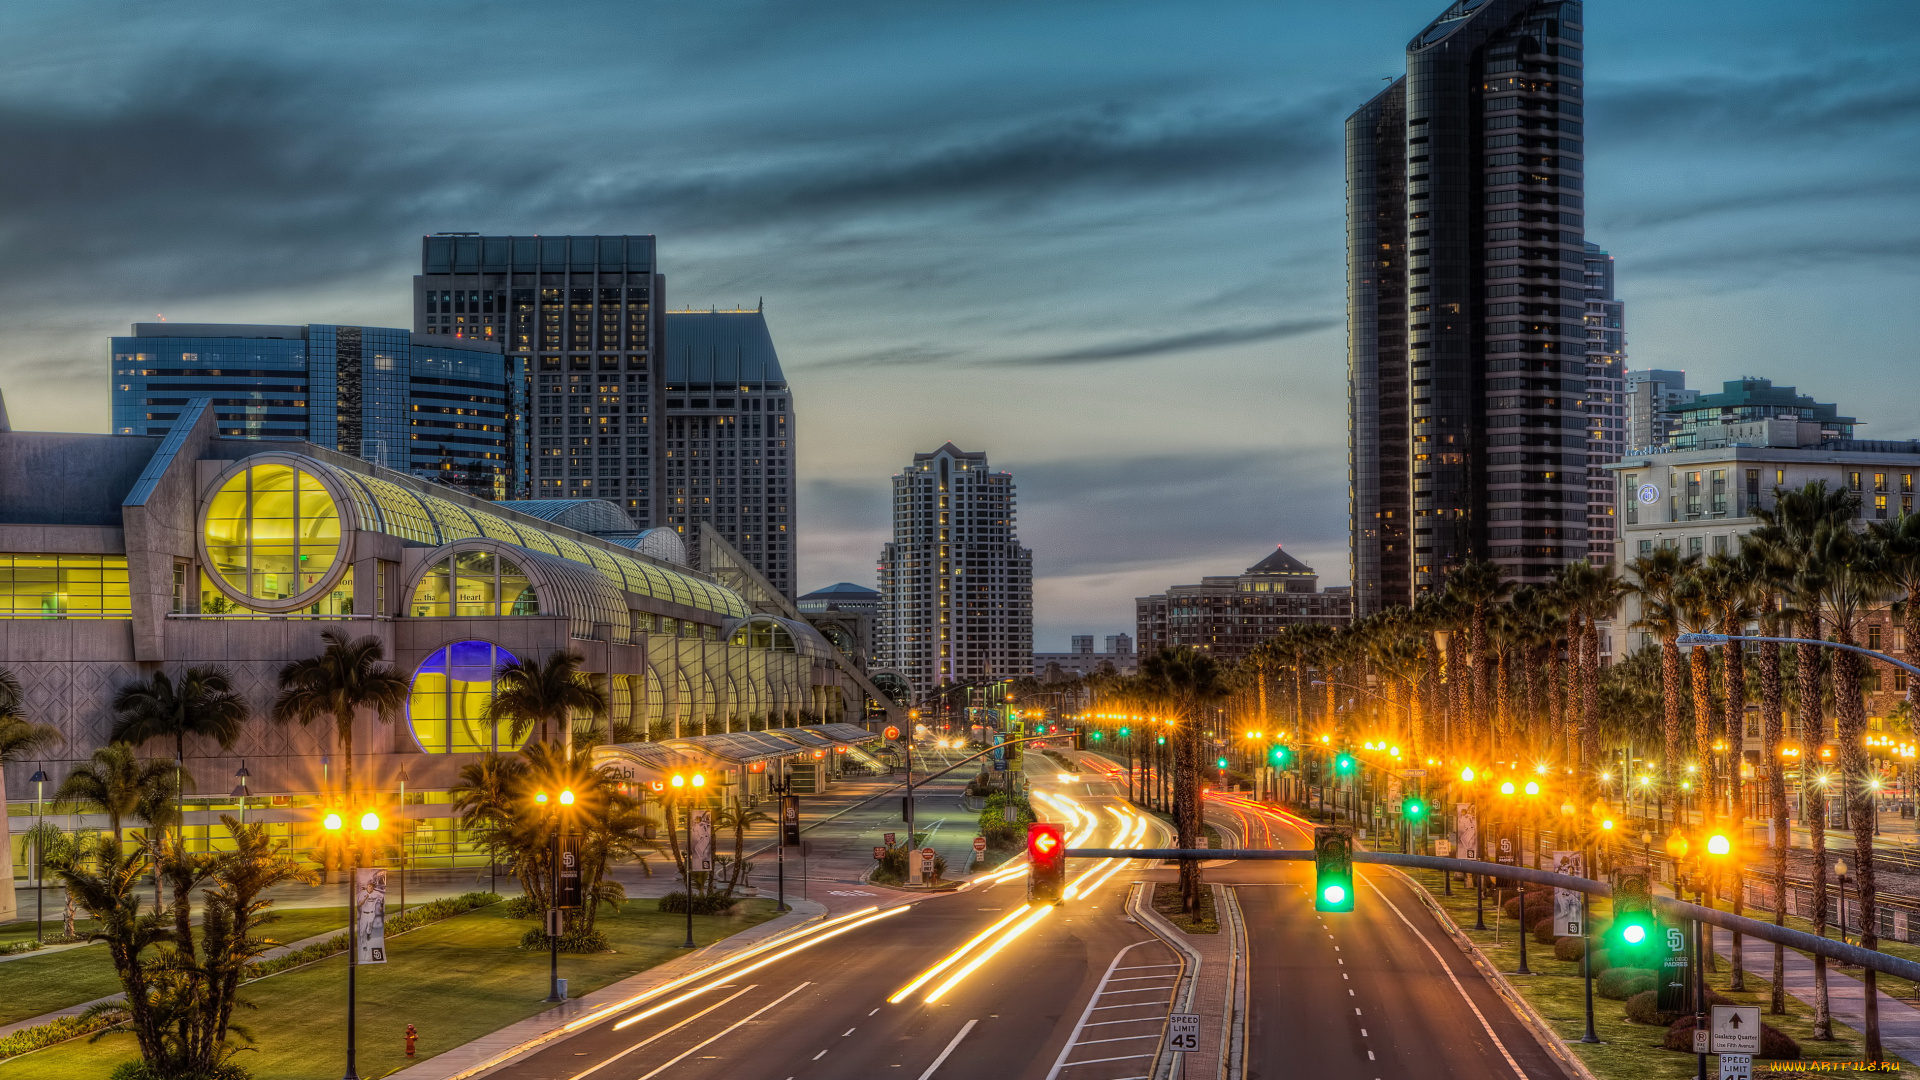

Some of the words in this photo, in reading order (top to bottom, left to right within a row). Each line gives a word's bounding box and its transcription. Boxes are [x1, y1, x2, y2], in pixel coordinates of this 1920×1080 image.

[460, 593, 481, 601] Heart
[886, 730, 895, 739] C
[1500, 838, 1512, 853] SD
[563, 851, 575, 868] SD
[1666, 927, 1685, 952] SD
[1171, 1016, 1199, 1024] SPEED
[1714, 1033, 1737, 1041] Gaslamp
[1171, 1034, 1197, 1049] 45
[1721, 1056, 1750, 1064] SPEED
[1724, 1065, 1748, 1073] LIMIT
